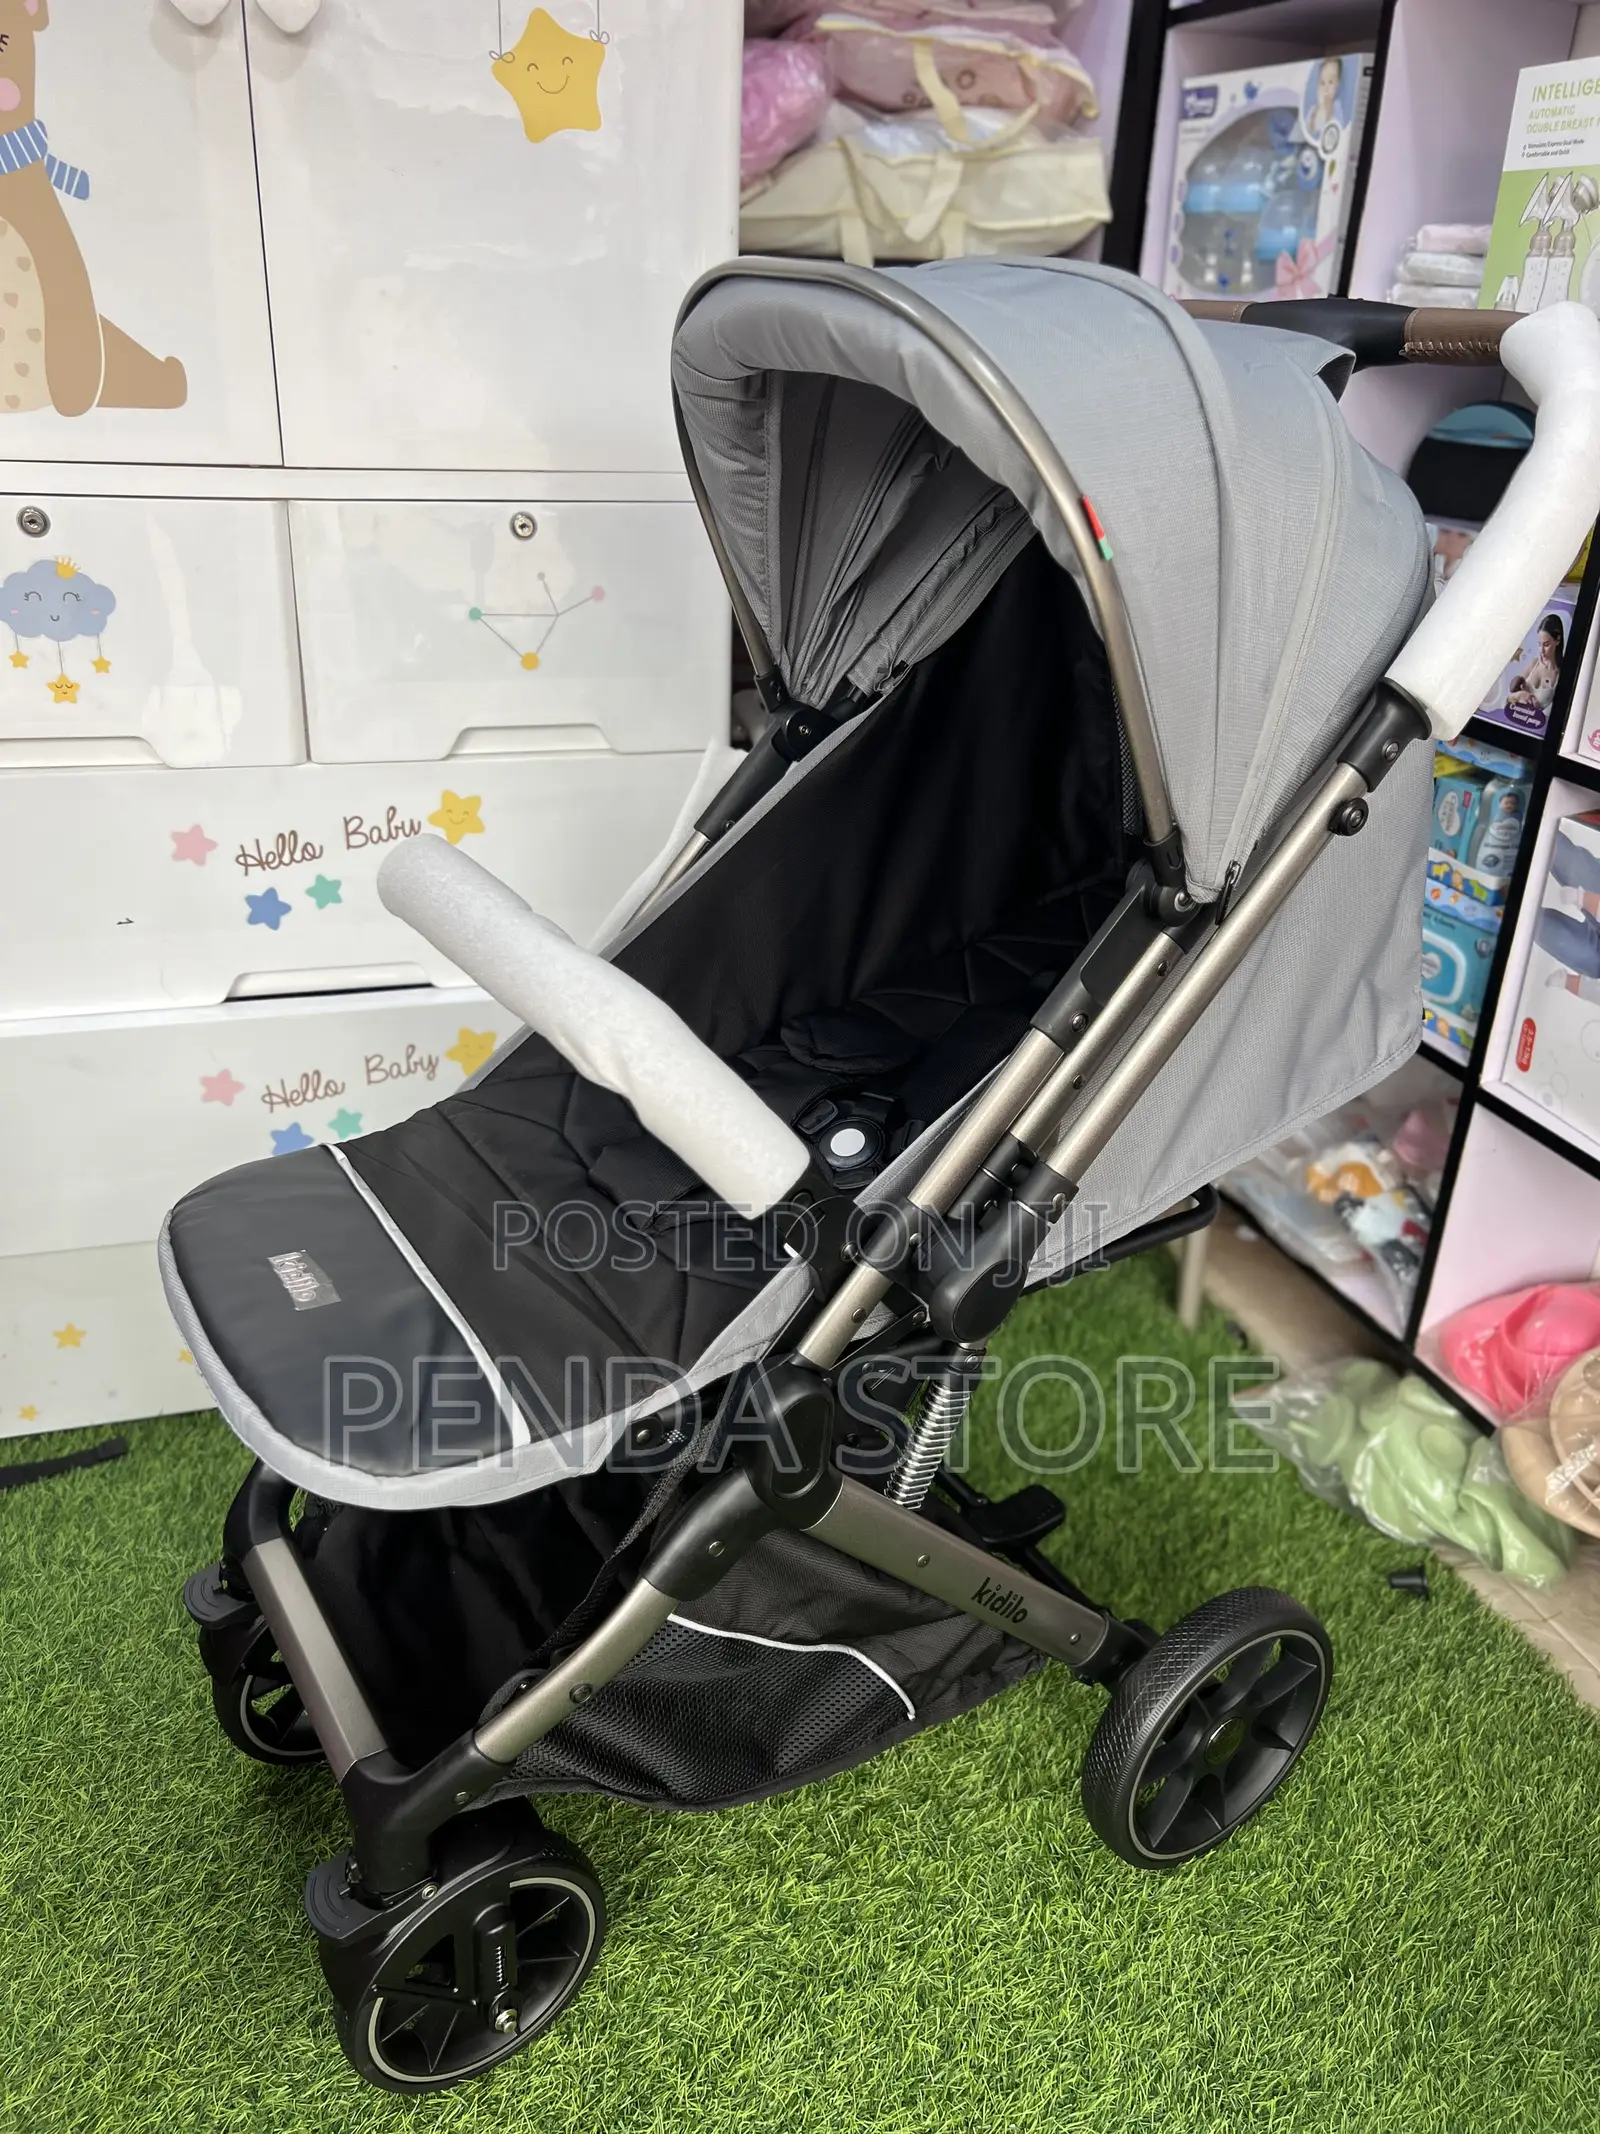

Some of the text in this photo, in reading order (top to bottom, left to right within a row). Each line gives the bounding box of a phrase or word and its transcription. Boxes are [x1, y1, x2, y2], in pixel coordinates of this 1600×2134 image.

[1527, 120, 1560, 134] DOUBLE
[1560, 117, 1595, 131] BREAST
[1529, 105, 1576, 120] AUTOMATIC
[235, 829, 324, 877] Hello
[261, 1043, 440, 1114] Hello Baby
[970, 1577, 1028, 1624] kidilo
